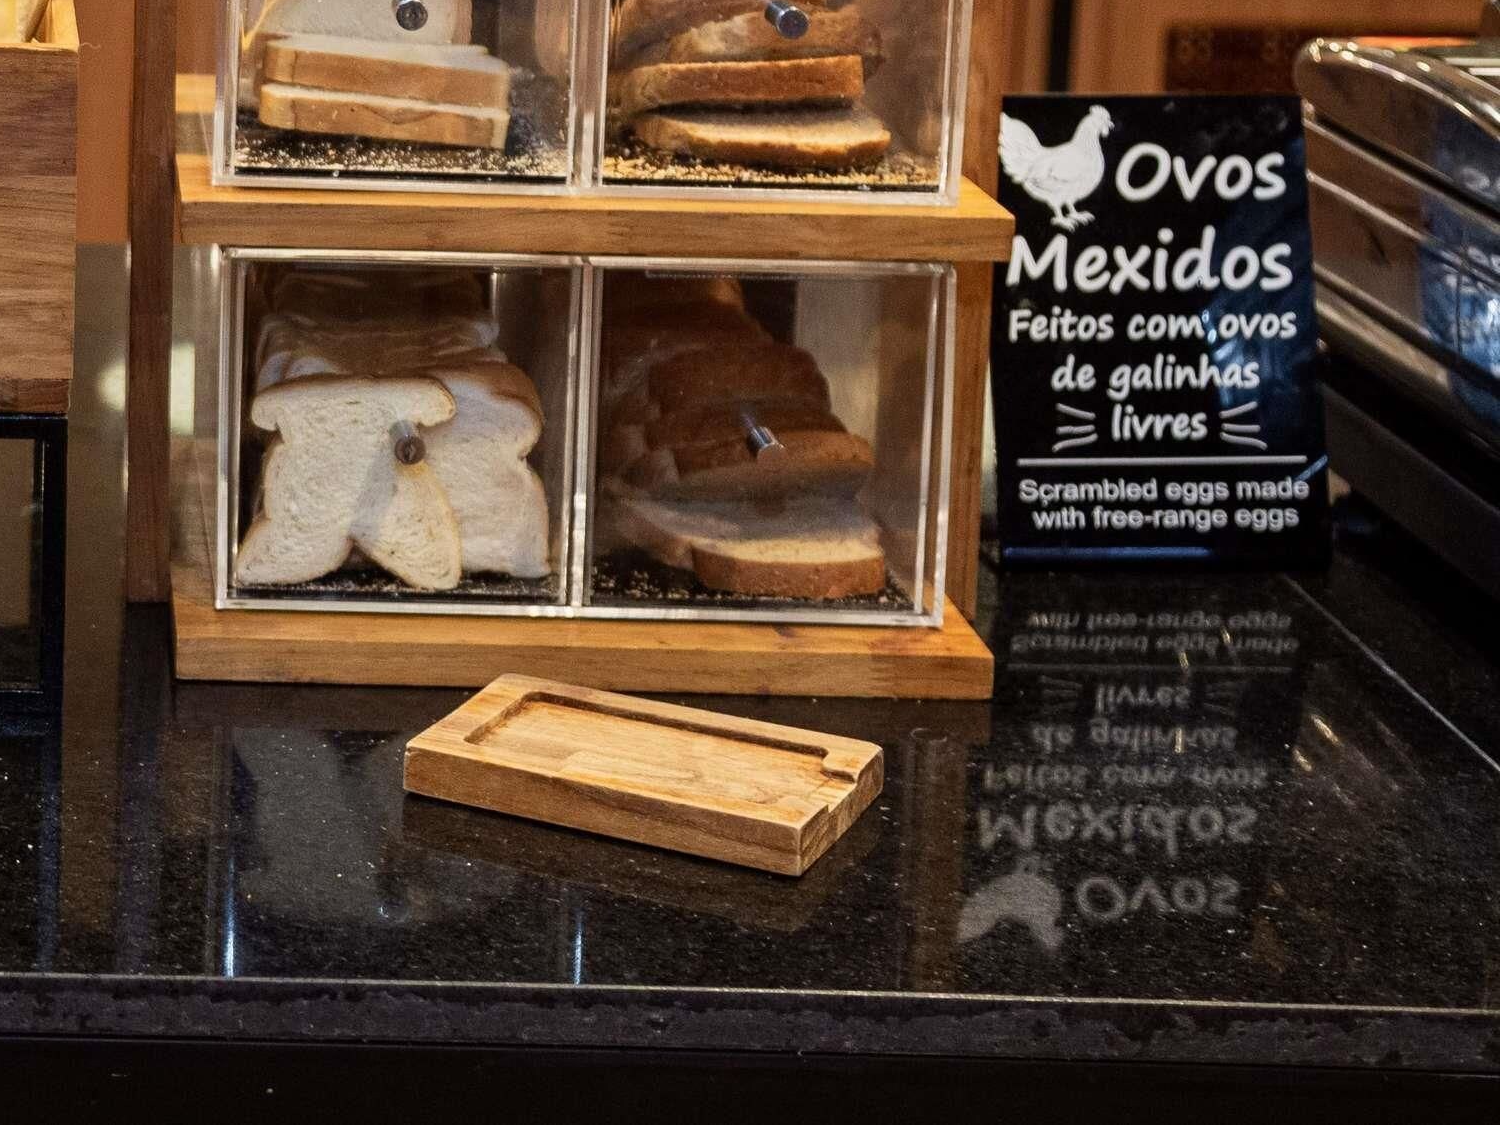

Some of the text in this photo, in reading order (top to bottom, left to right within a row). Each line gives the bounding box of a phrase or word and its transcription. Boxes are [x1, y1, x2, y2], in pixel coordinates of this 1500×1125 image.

[1115, 143, 1286, 201] Ovos
[1006, 224, 1293, 293] Mexidos
[1009, 305, 1114, 341] Feitos
[1218, 311, 1297, 339] ovos
[1051, 353, 1260, 400] de galinhas
[1112, 403, 1208, 440] livres
[1019, 477, 1311, 505] Scrambled eggs made
[1032, 505, 1299, 532] with free-range eggs
